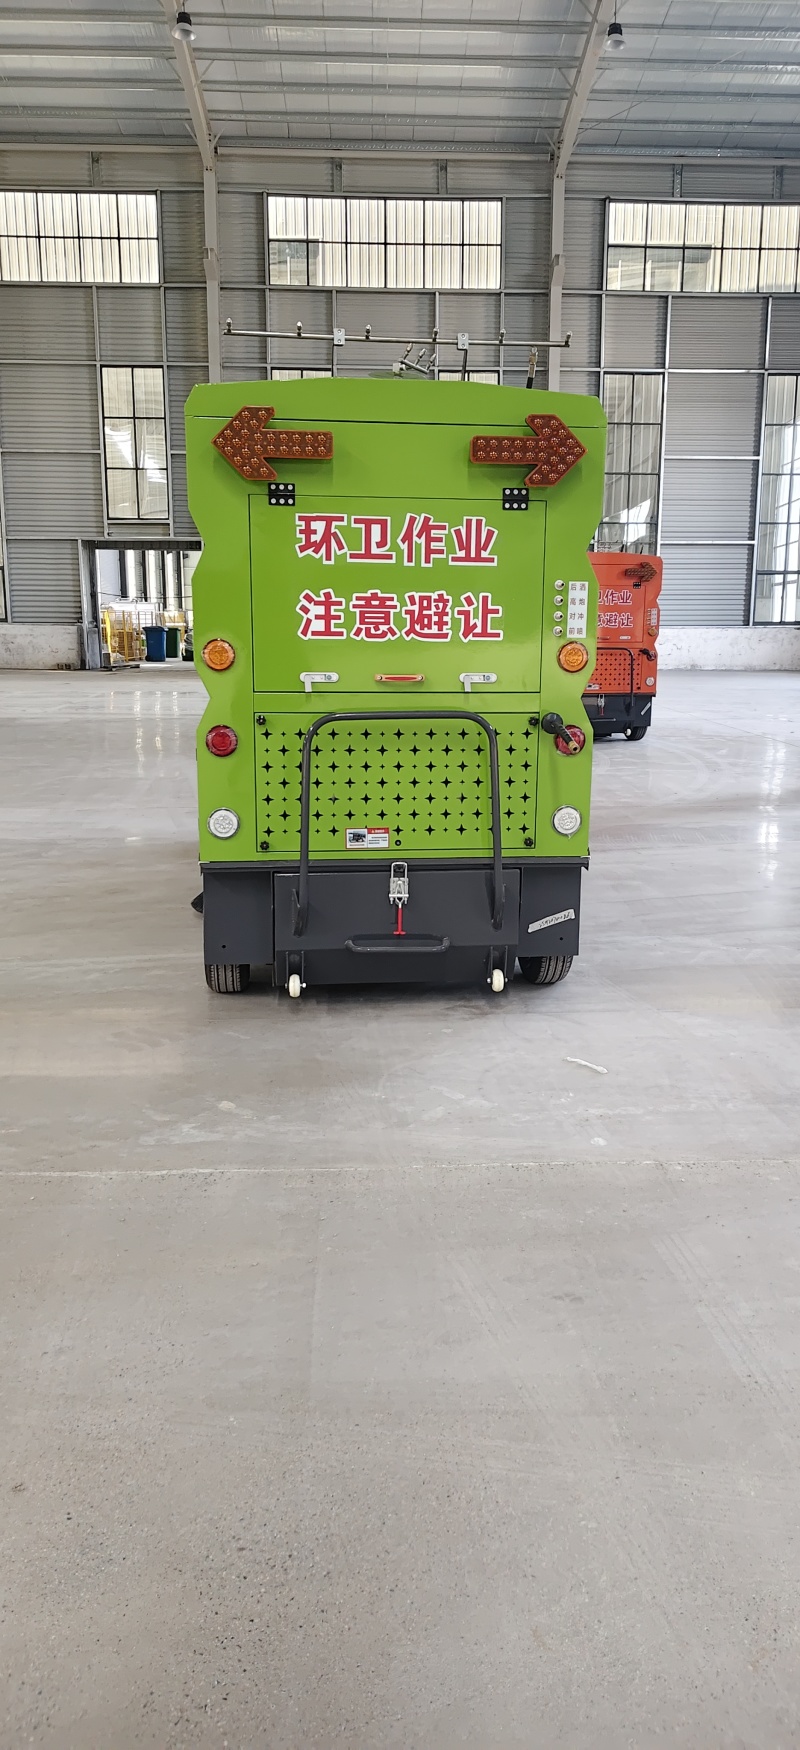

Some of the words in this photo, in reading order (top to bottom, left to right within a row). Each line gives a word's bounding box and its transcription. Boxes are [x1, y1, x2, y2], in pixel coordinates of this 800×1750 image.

[295, 513, 498, 567] 环卫作业
[296, 588, 503, 642] 注意避让
